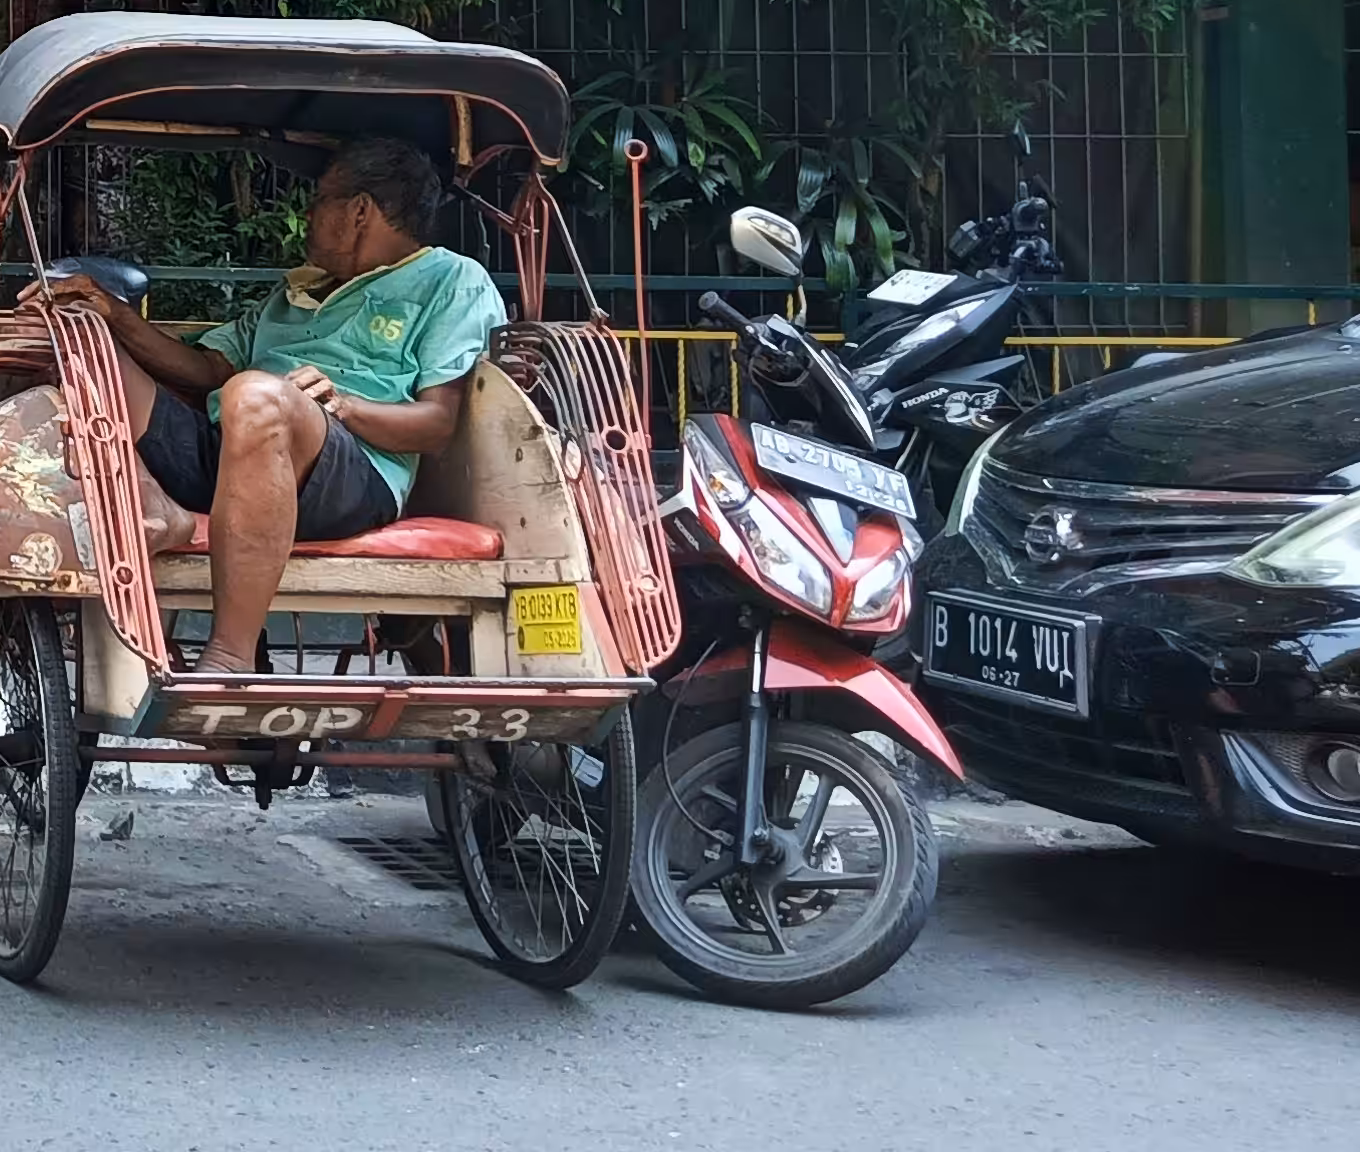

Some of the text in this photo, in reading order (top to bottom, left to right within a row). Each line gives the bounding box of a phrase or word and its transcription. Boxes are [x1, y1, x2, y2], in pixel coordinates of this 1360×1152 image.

[369, 315, 402, 341] 05
[901, 387, 950, 408] HONDA
[935, 605, 948, 647] B
[968, 612, 1018, 663] 1014
[190, 705, 364, 739] TOP
